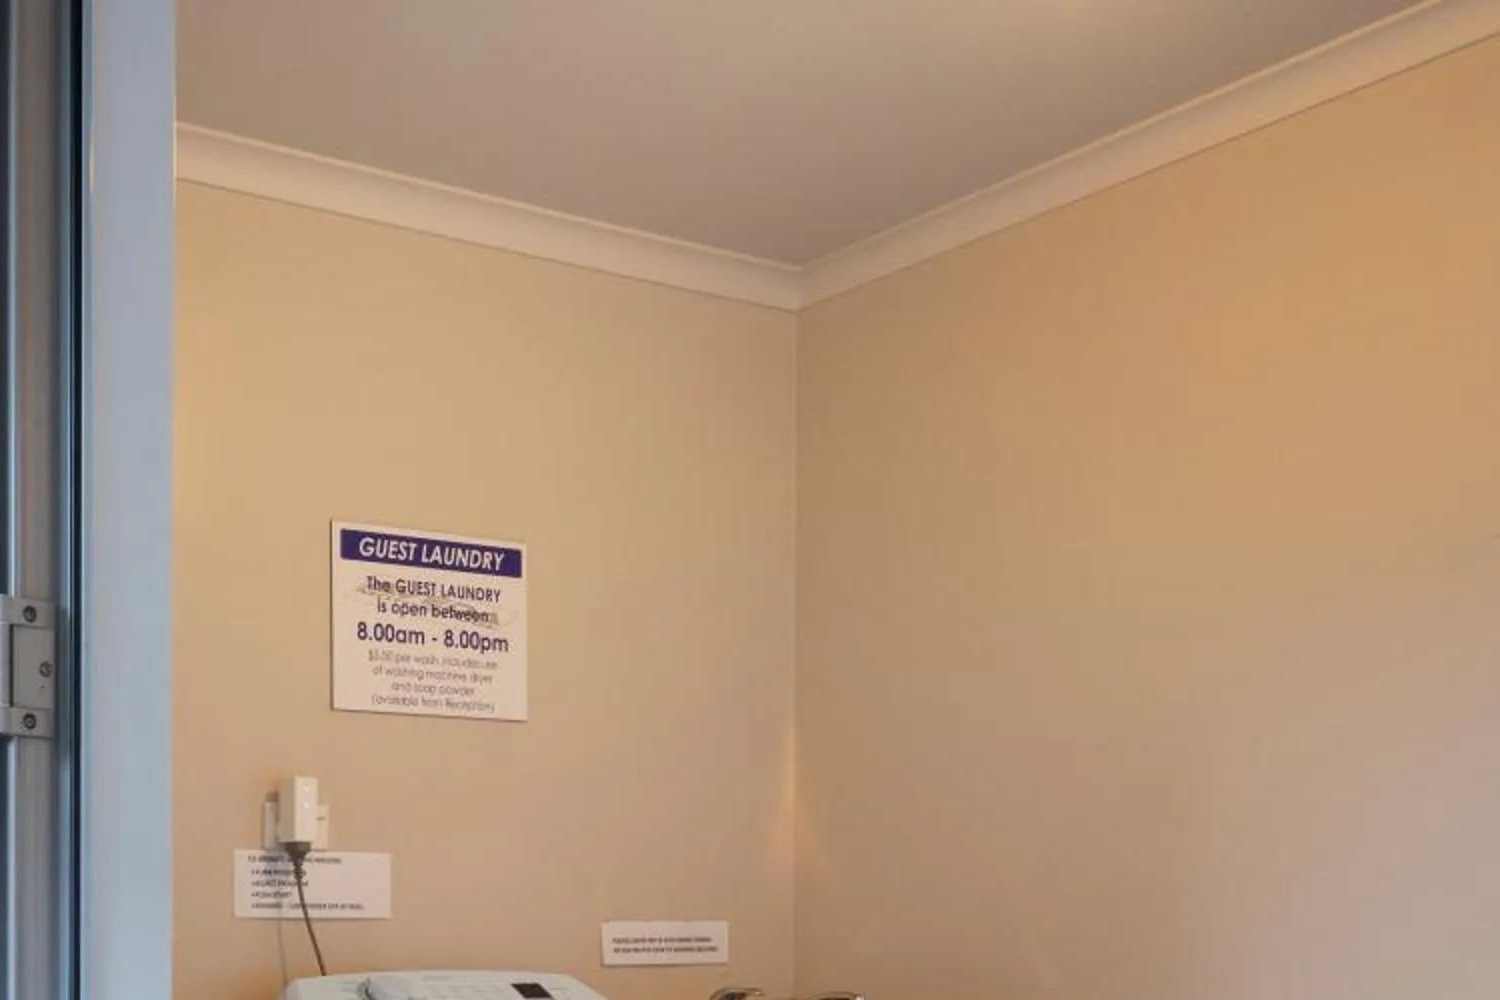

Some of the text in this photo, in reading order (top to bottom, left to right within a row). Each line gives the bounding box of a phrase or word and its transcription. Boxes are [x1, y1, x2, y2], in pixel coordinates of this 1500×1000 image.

[359, 537, 505, 571] GUEST LAUNDRY
[366, 576, 501, 603] The GUEST LAUNDRY
[391, 604, 426, 620] open
[431, 605, 489, 624] between
[357, 621, 425, 645] 8.00am
[443, 630, 509, 654] 8.00pm
